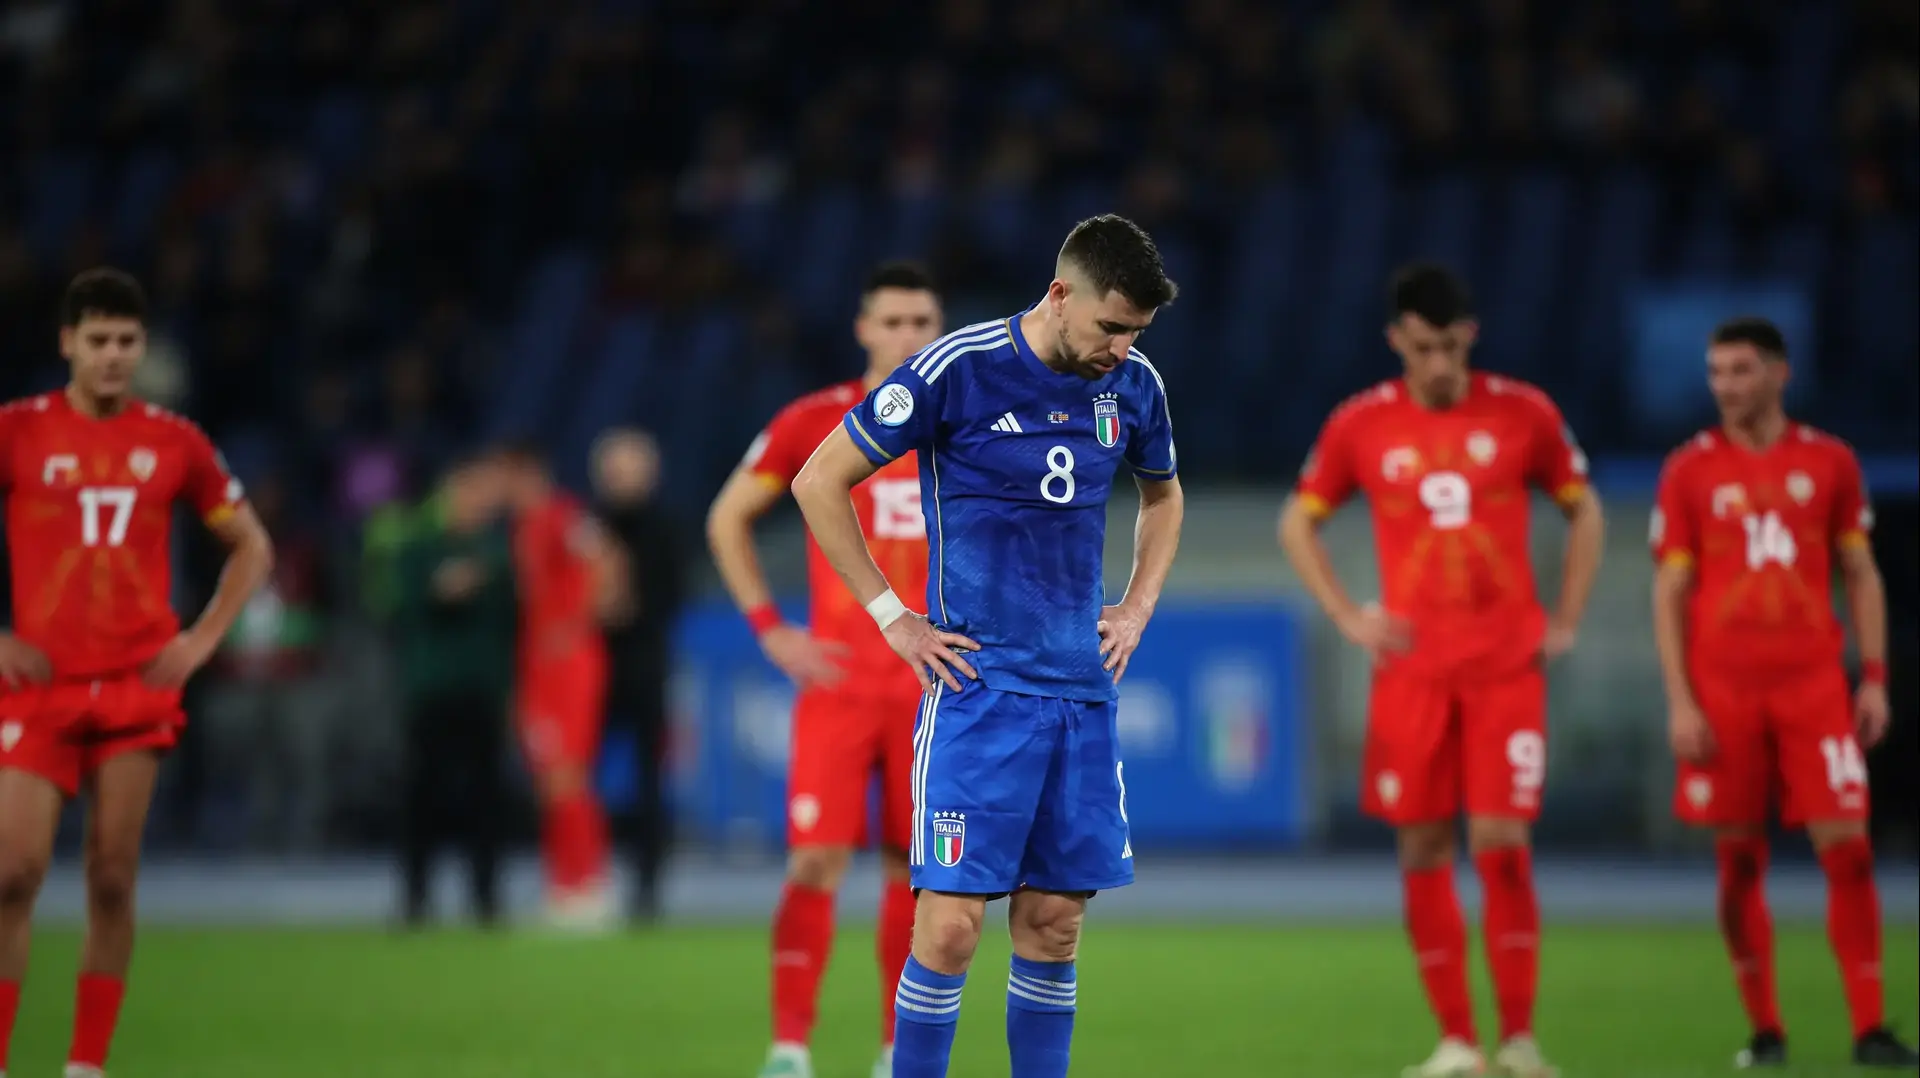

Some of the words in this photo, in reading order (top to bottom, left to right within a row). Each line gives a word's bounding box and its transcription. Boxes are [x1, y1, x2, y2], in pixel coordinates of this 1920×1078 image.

[1097, 404, 1116, 414] ITALIA
[1040, 445, 1075, 503] 8
[1419, 471, 1471, 530] 9
[78, 487, 137, 546] 17
[870, 480, 925, 538] 15
[1741, 510, 1798, 572] 14
[1507, 729, 1545, 789] 9
[1819, 734, 1868, 792] 14
[935, 823, 962, 834] ITALIA
